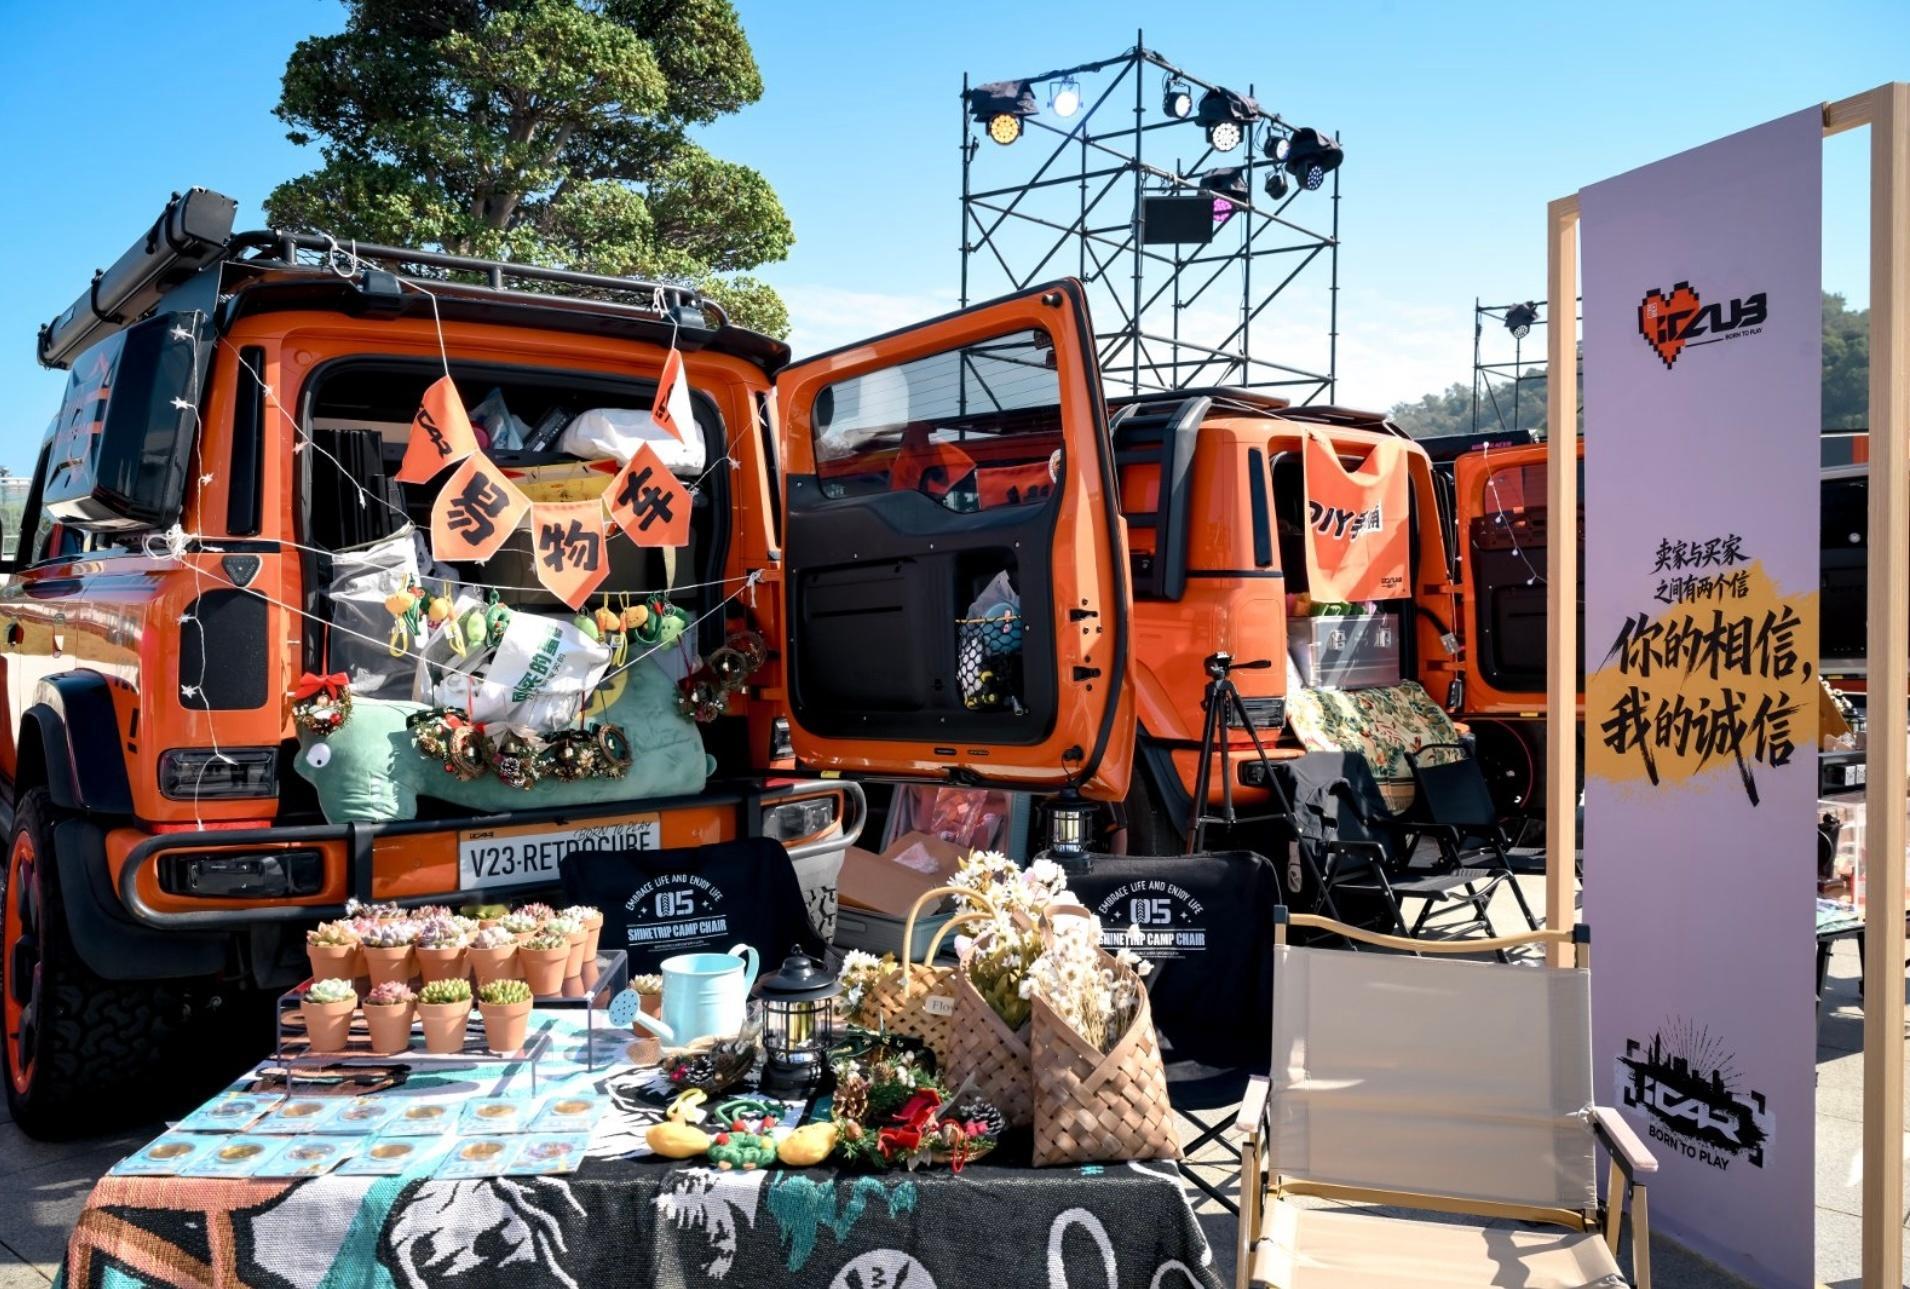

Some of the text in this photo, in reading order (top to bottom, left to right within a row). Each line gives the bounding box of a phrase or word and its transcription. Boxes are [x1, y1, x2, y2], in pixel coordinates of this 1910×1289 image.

[1725, 332, 1741, 340] BORN
[1750, 327, 1763, 335] PLAY
[1649, 533, 1752, 575] 卖家与买家
[1653, 570, 1750, 604] 之间有两个信
[1600, 687, 1810, 807] 我的诚信
[625, 874, 723, 911] EMBRACE LIFE AND ENJOY LIFE
[655, 889, 694, 918] 05
[1098, 880, 1204, 915] EMBRACE LIFE AND ENJOY LIFE
[1130, 898, 1171, 924] 05
[672, 922, 699, 938] CAMP
[699, 919, 727, 934] CHAIR
[1147, 932, 1175, 946] CAMP
[1176, 932, 1205, 946] CHAIR
[1649, 1125, 1730, 1172] BORN TO PLAY
